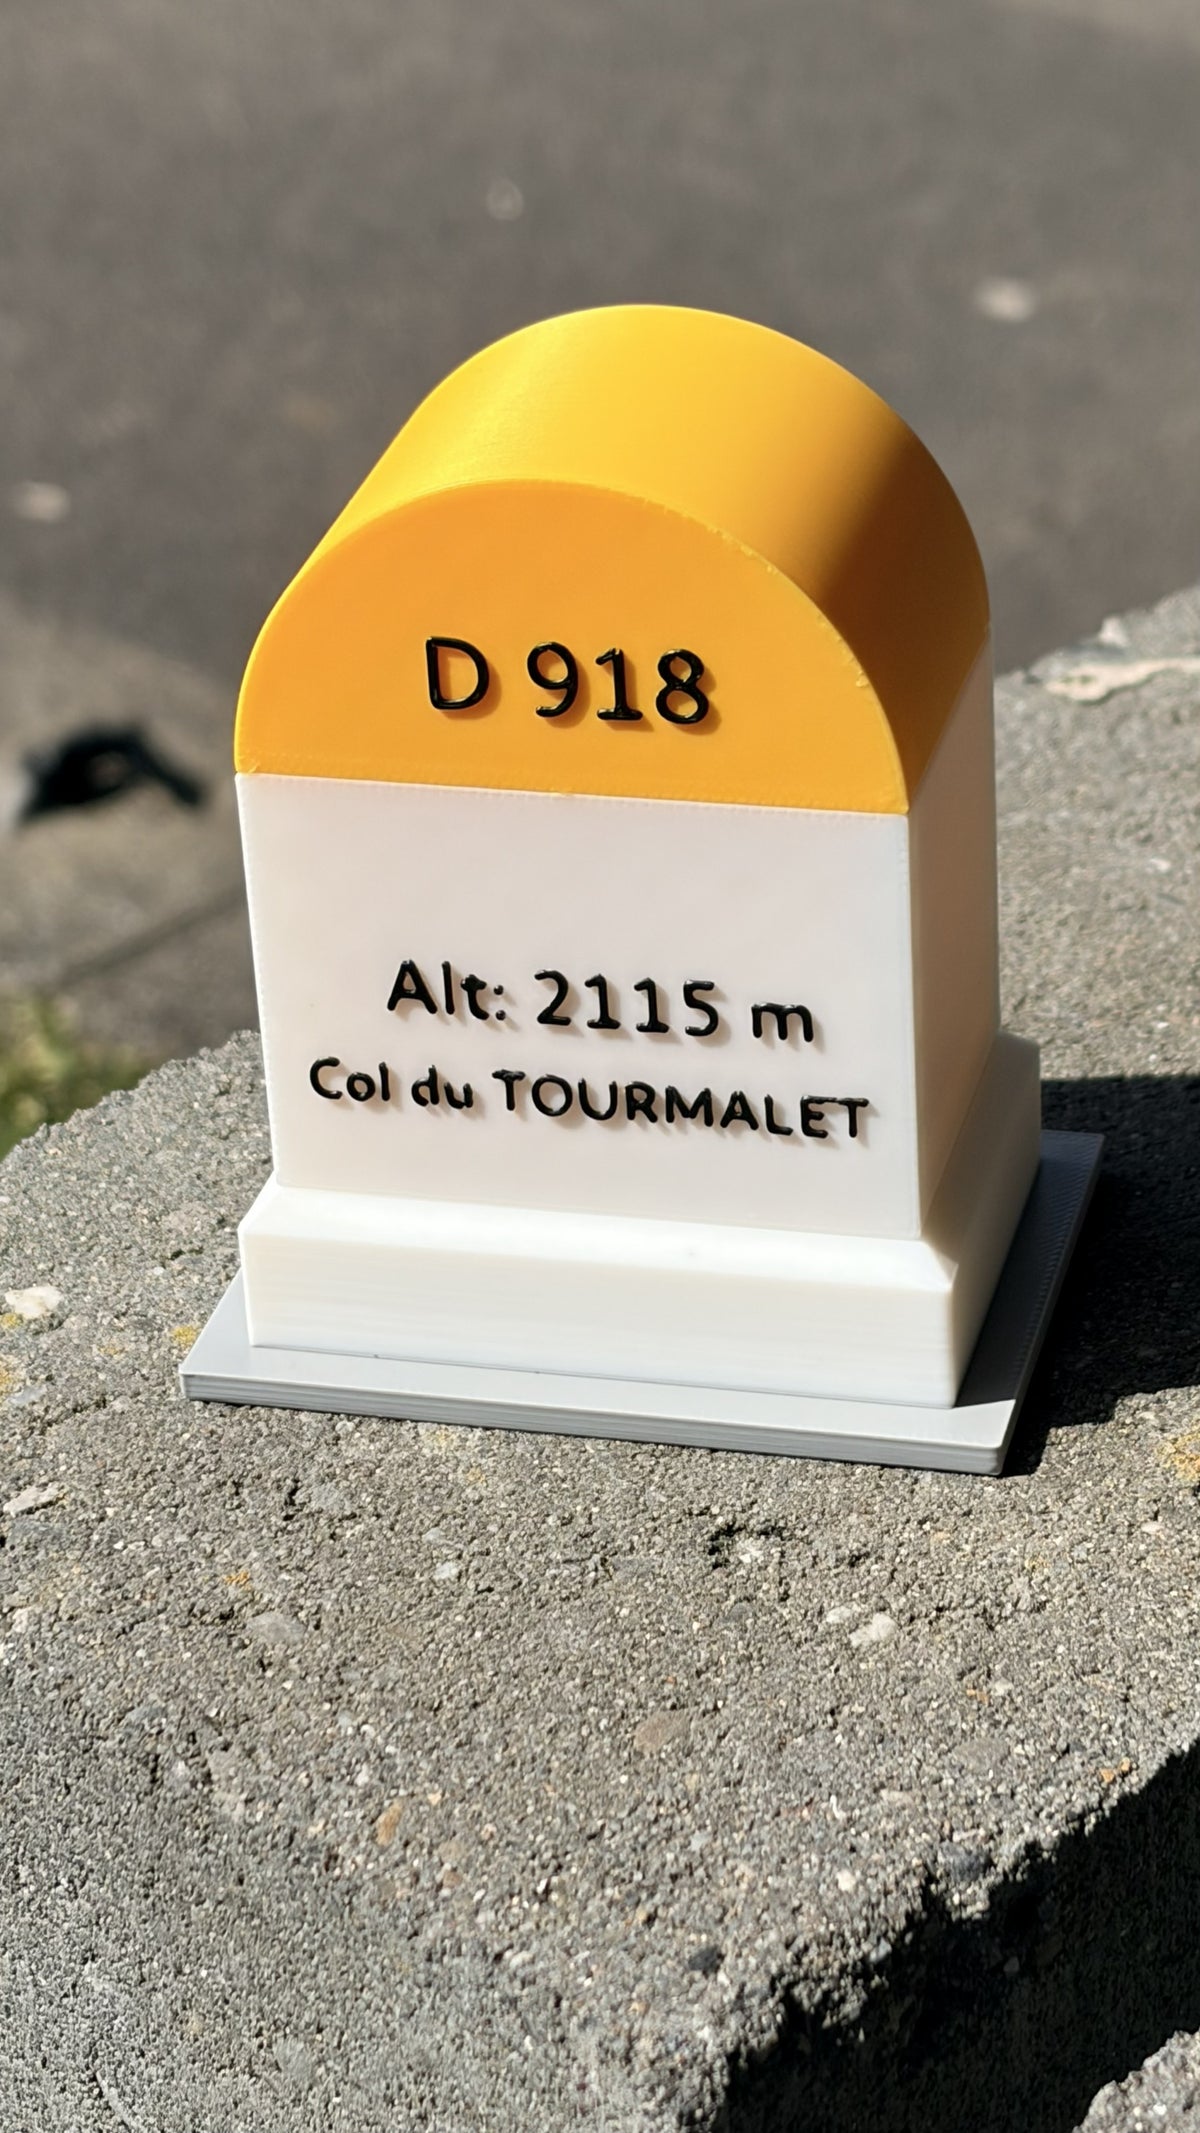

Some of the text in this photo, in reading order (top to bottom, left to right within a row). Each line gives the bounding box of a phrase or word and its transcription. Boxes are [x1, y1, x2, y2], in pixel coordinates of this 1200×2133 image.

[424, 636, 710, 725] D 918
[387, 958, 814, 1043] Alt: 2115 m
[308, 1056, 871, 1140] Col du TOURMALET
